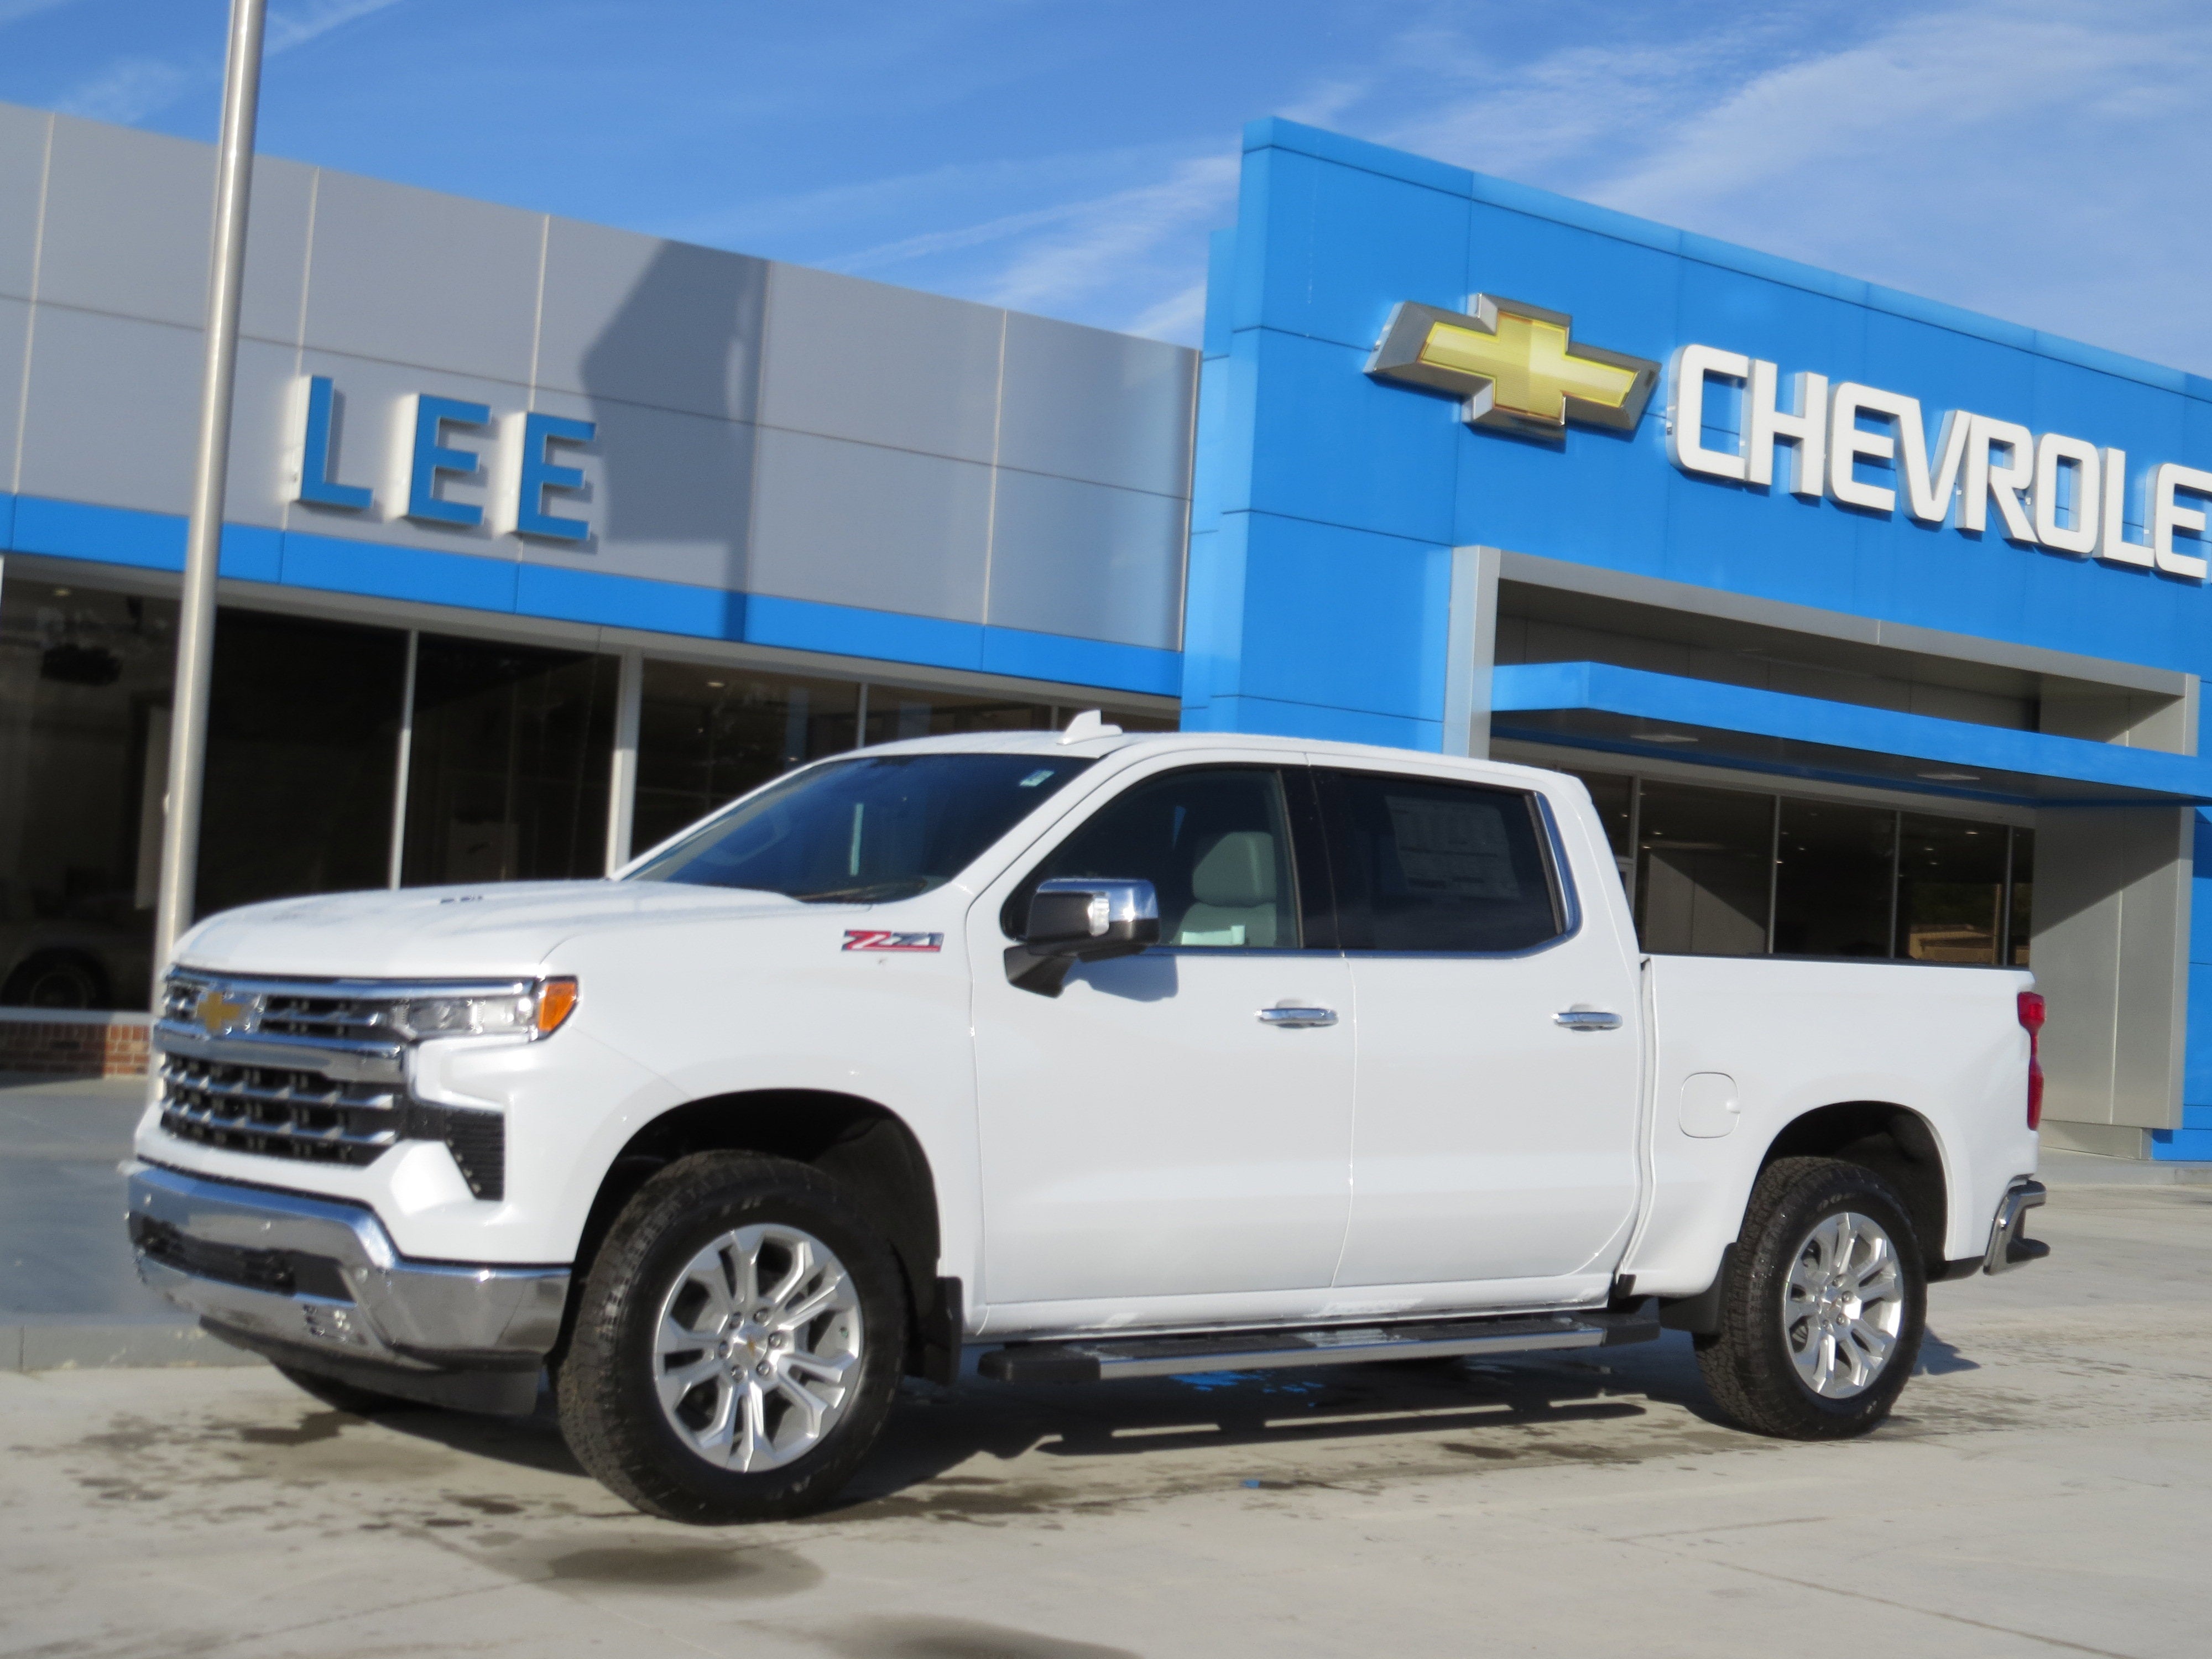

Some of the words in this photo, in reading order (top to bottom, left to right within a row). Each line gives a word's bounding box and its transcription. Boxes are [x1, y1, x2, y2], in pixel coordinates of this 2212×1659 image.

[296, 374, 597, 540] LEE
[1667, 343, 2212, 579] CHEVROLE
[841, 929, 943, 952] Z71
